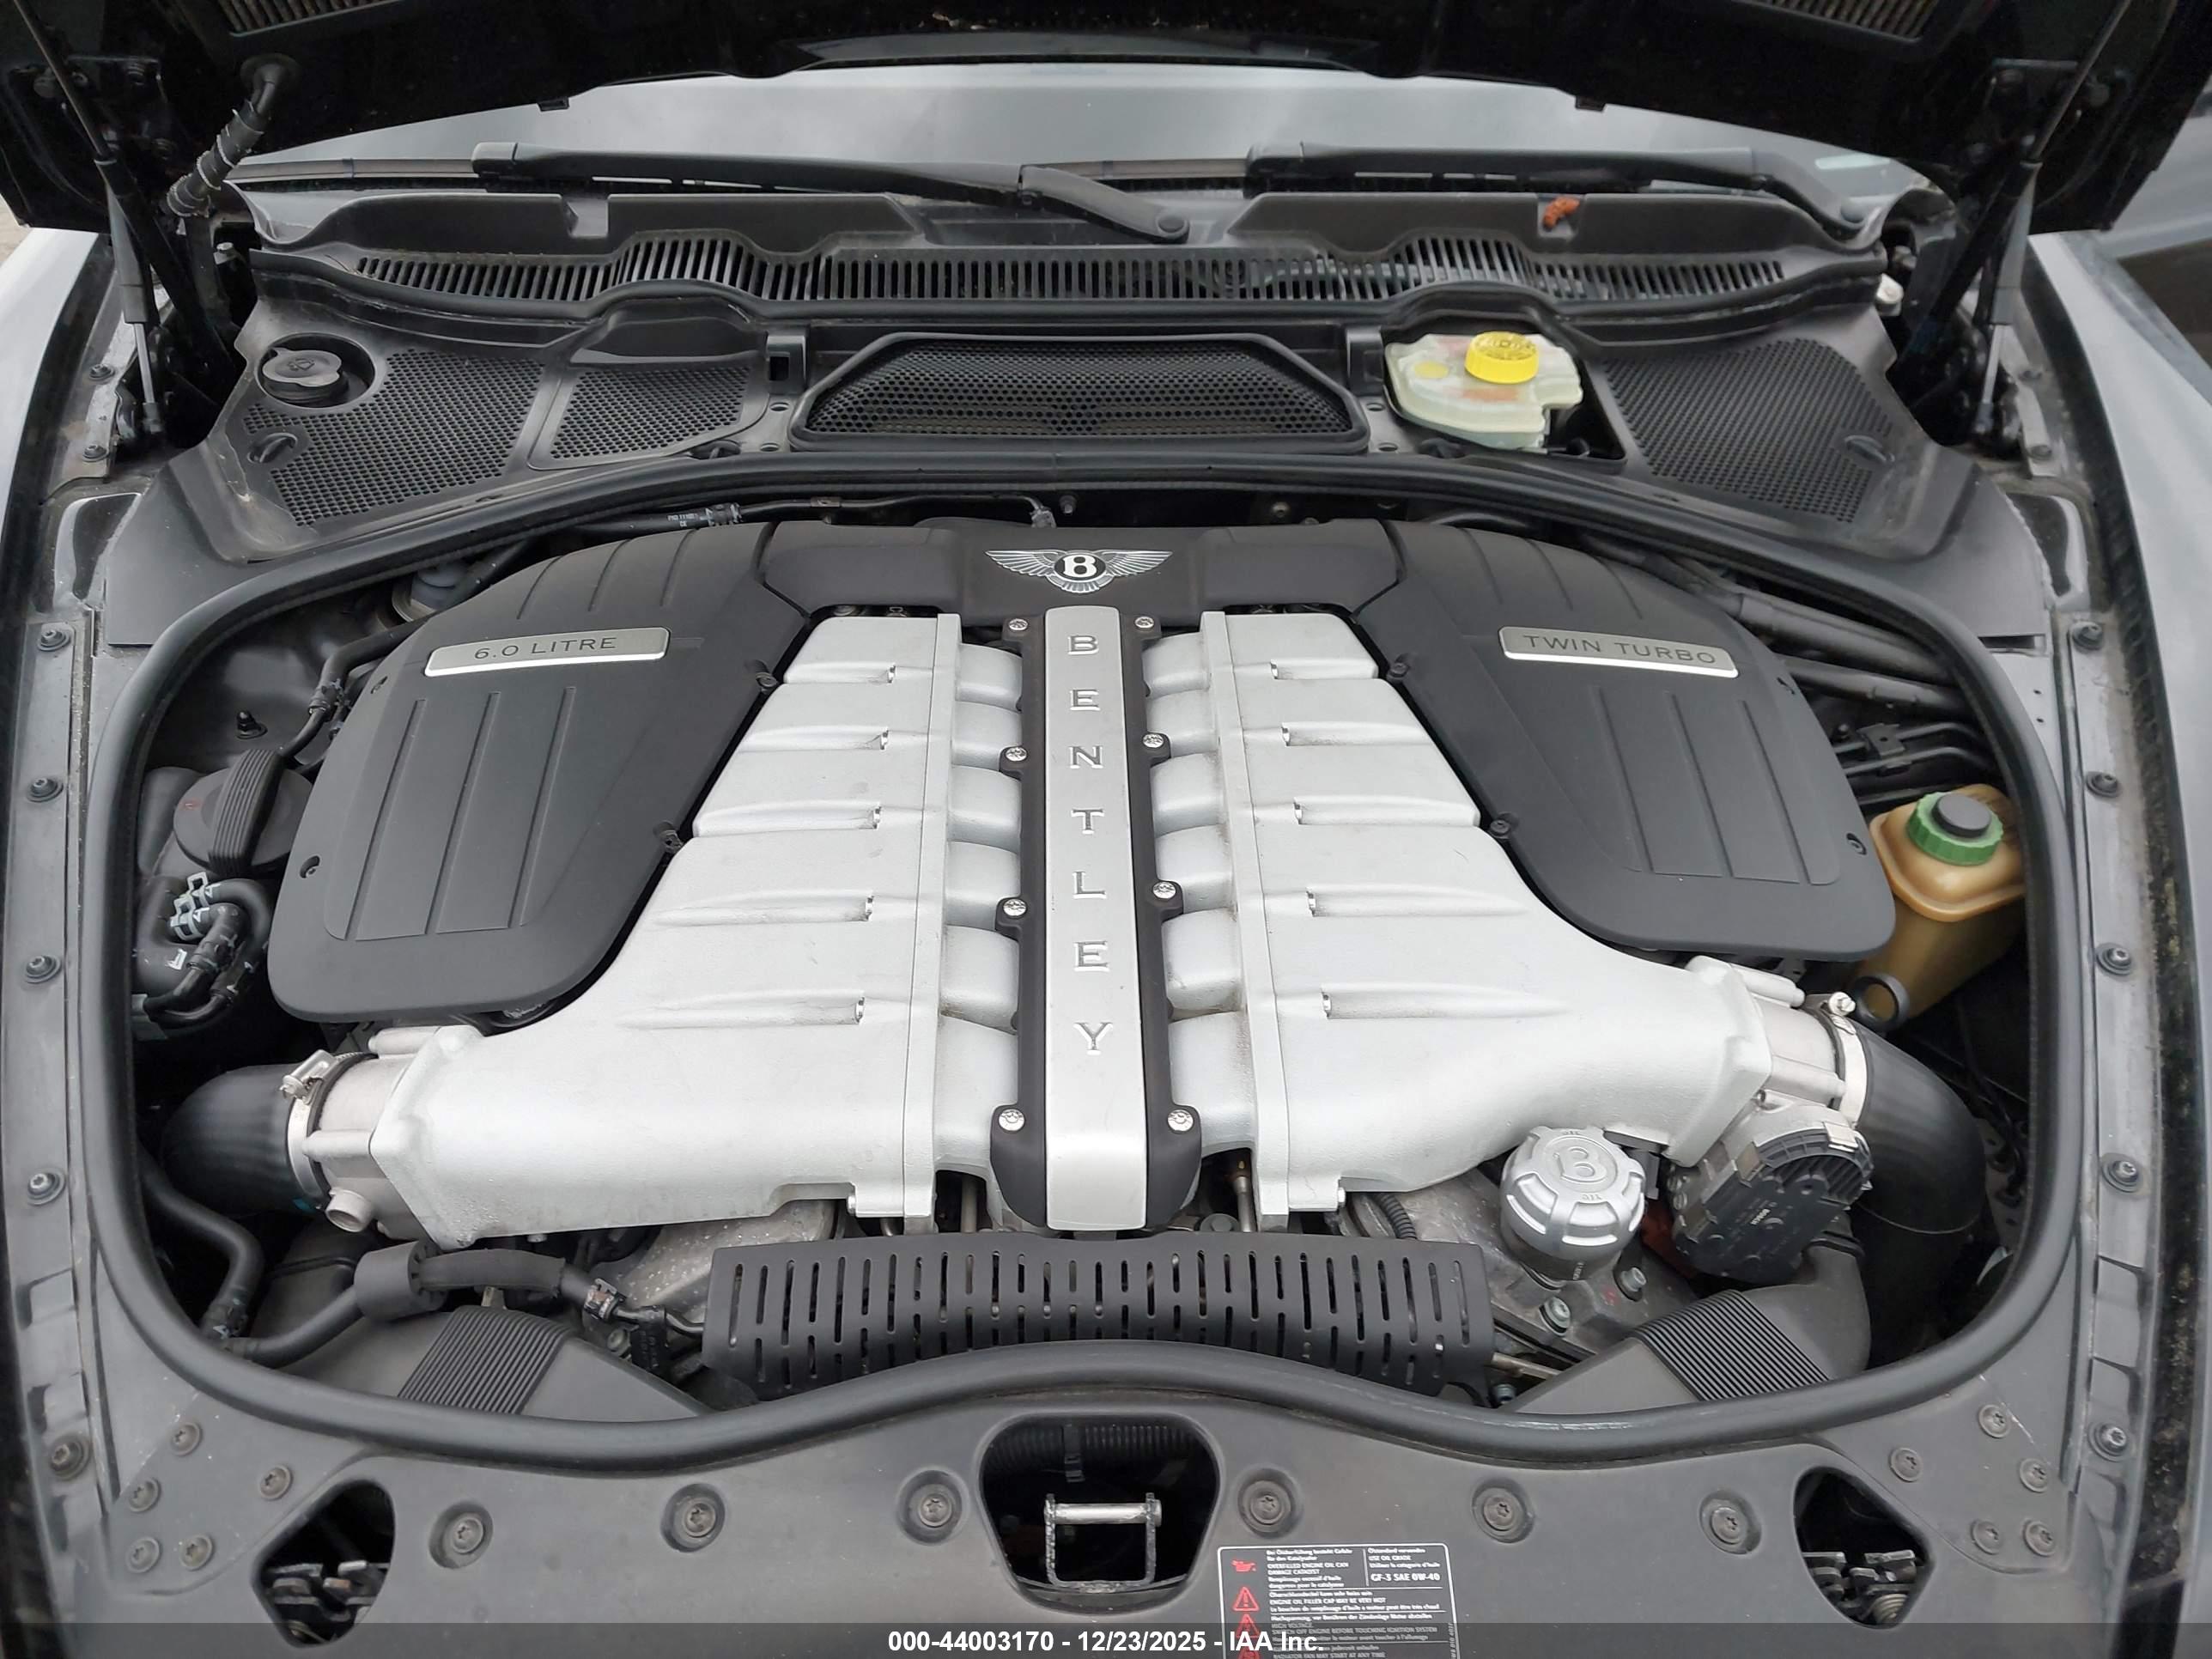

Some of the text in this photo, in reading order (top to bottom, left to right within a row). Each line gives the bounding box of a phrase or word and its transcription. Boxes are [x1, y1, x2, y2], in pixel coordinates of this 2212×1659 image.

[1063, 554, 1097, 578] B
[474, 637, 617, 659] 6.0 LITRE
[1522, 635, 1716, 664] TWIN TURBO
[1067, 634, 1113, 1055] BENTLEY
